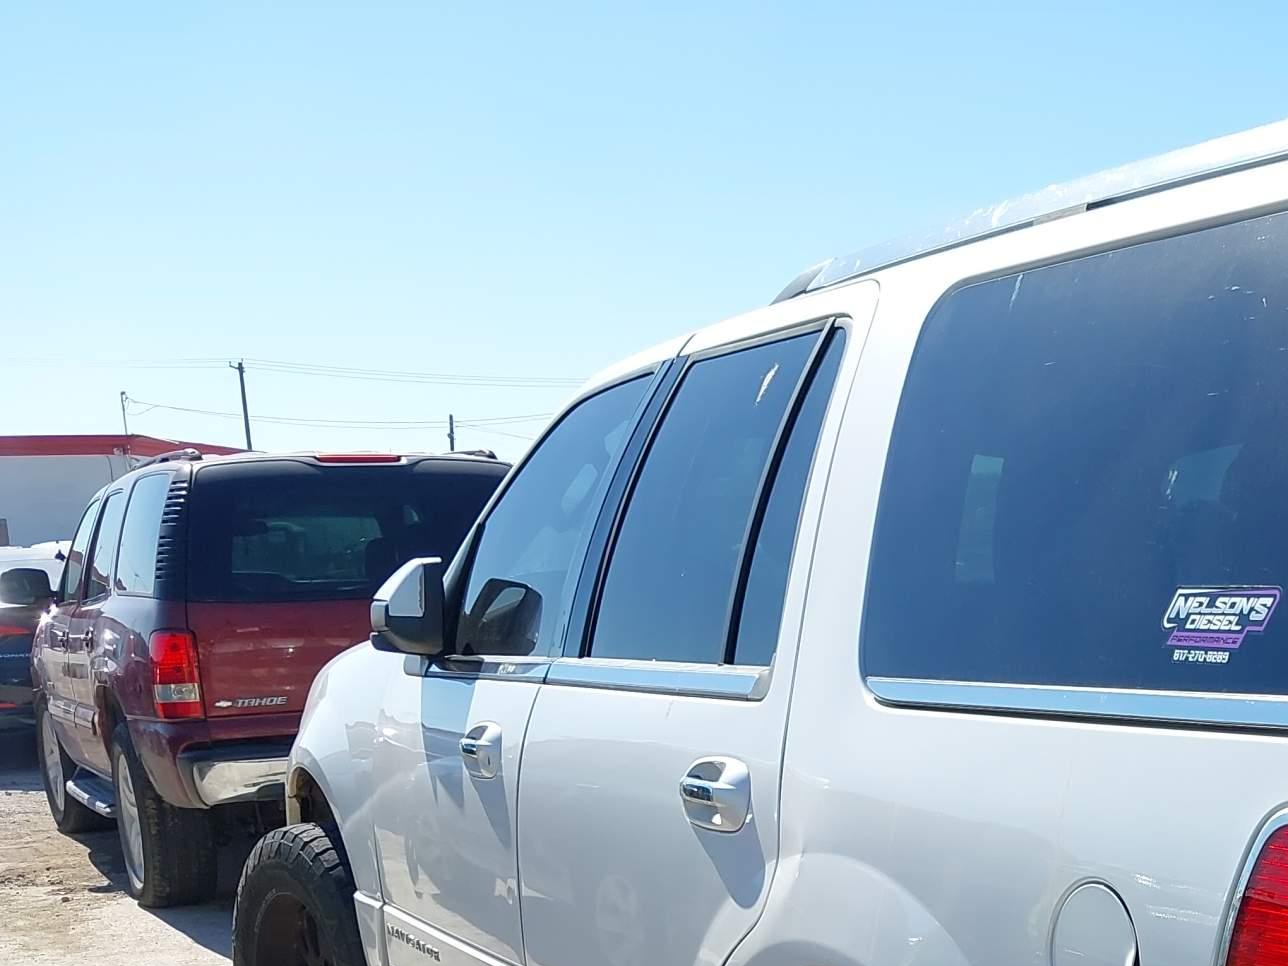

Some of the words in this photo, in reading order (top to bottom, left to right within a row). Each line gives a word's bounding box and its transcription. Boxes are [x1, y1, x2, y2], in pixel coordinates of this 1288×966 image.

[1169, 596, 1274, 620] NELSON'S
[1185, 614, 1242, 630] DIESEL
[234, 696, 288, 708] TAHOE
